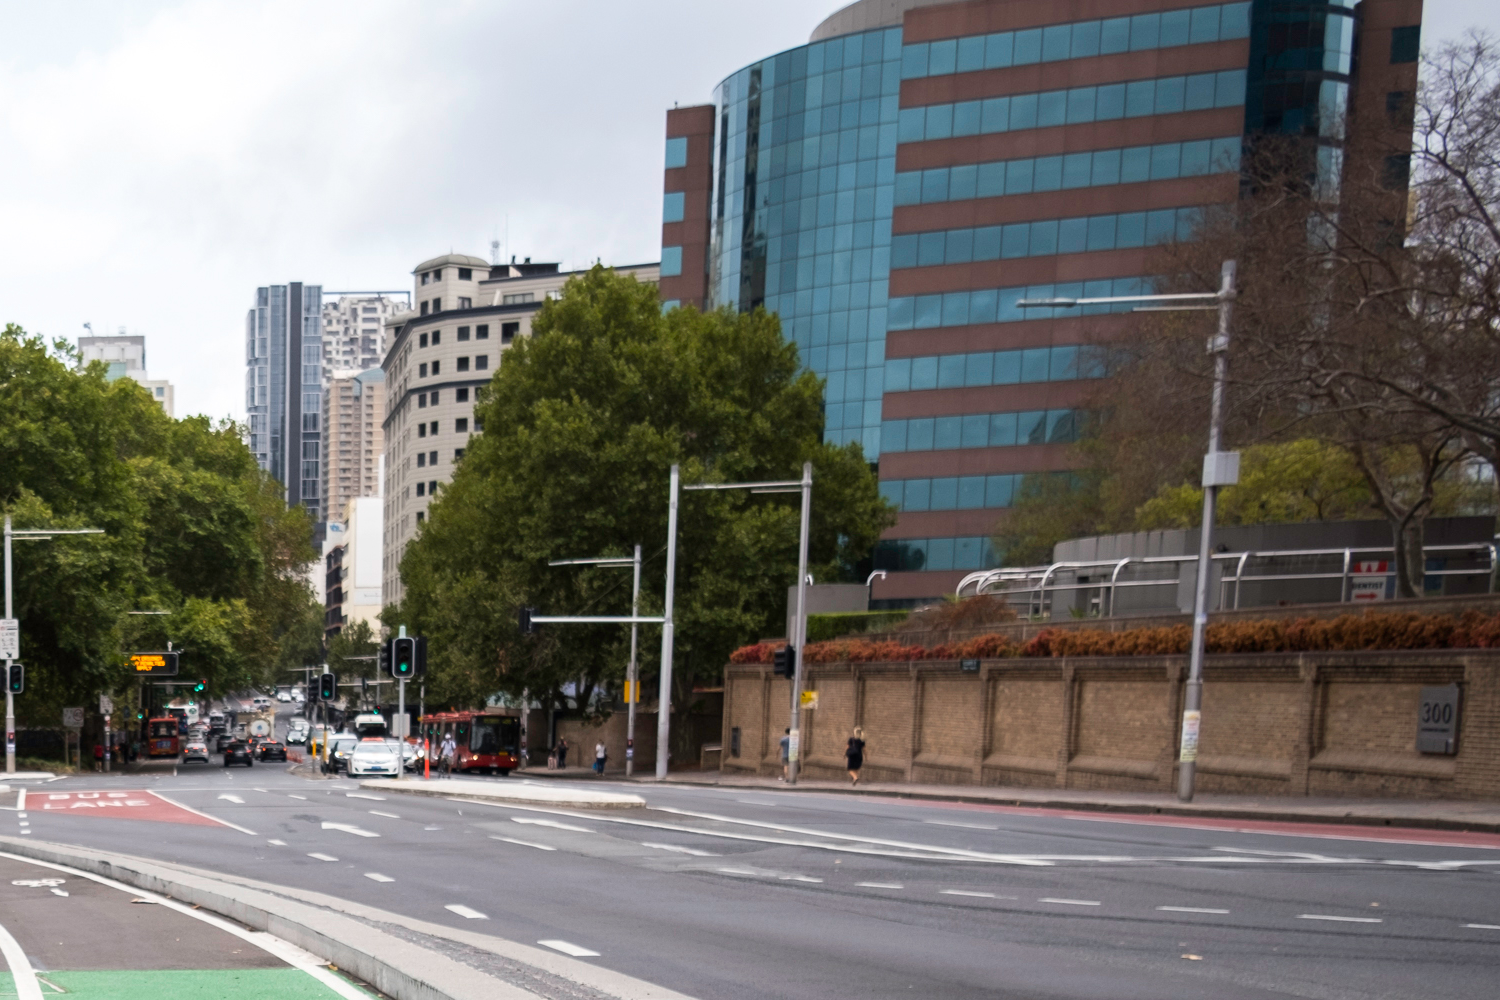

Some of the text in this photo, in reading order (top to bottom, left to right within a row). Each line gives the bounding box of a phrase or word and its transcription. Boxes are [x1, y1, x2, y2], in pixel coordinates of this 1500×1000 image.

[1422, 702, 1452, 724] 300
[48, 793, 129, 801] BUS
[43, 800, 151, 810] LANE
